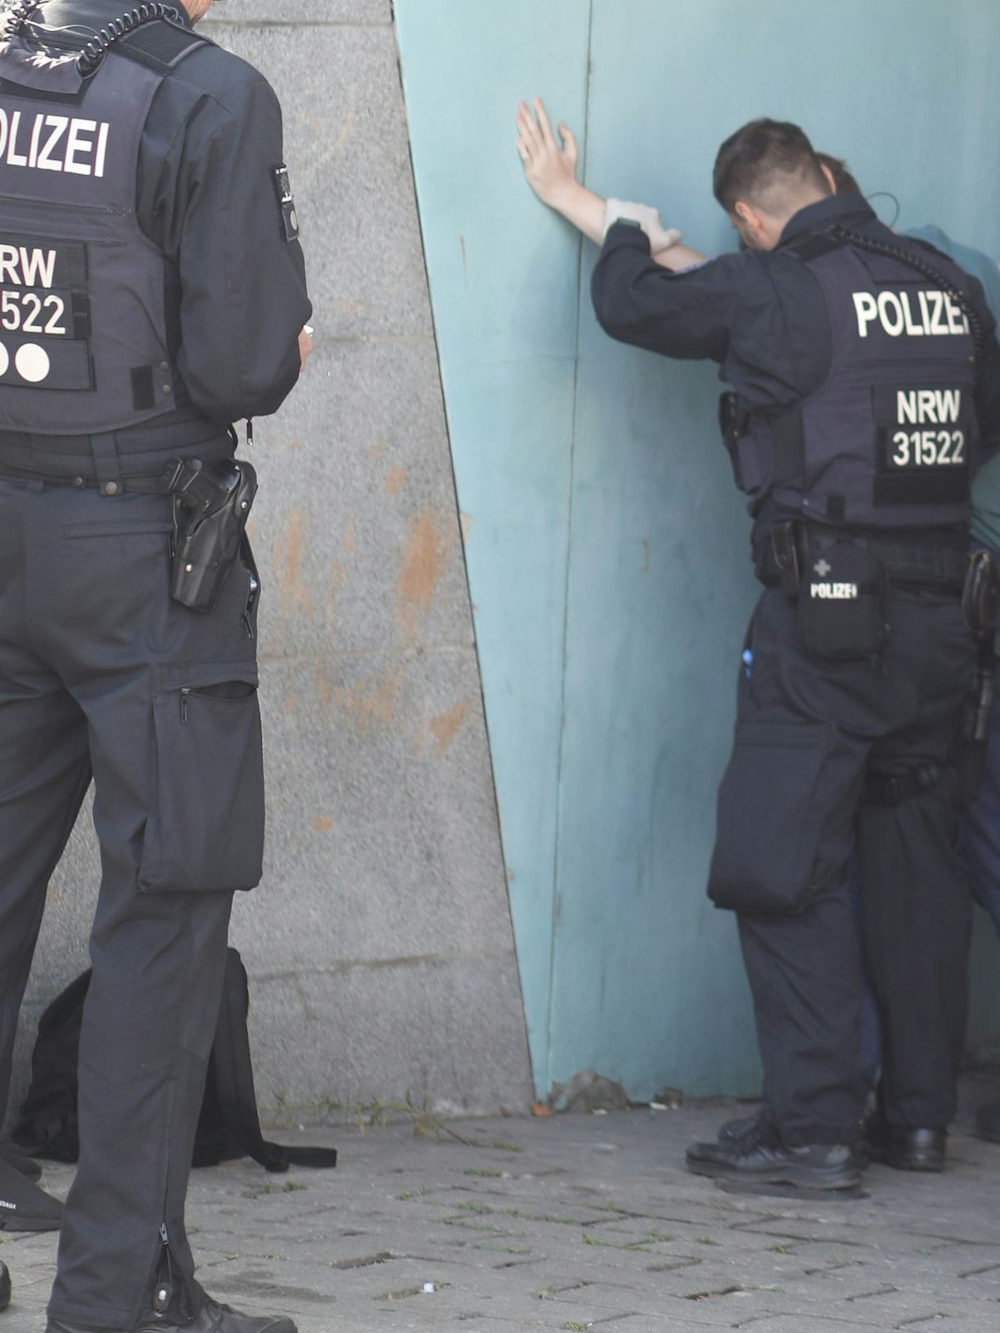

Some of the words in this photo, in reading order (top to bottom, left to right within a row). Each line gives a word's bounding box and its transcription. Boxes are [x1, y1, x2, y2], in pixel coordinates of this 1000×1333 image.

[897, 389, 961, 424] NRW
[892, 430, 965, 466] 31522
[810, 582, 858, 599] POLIZEI
